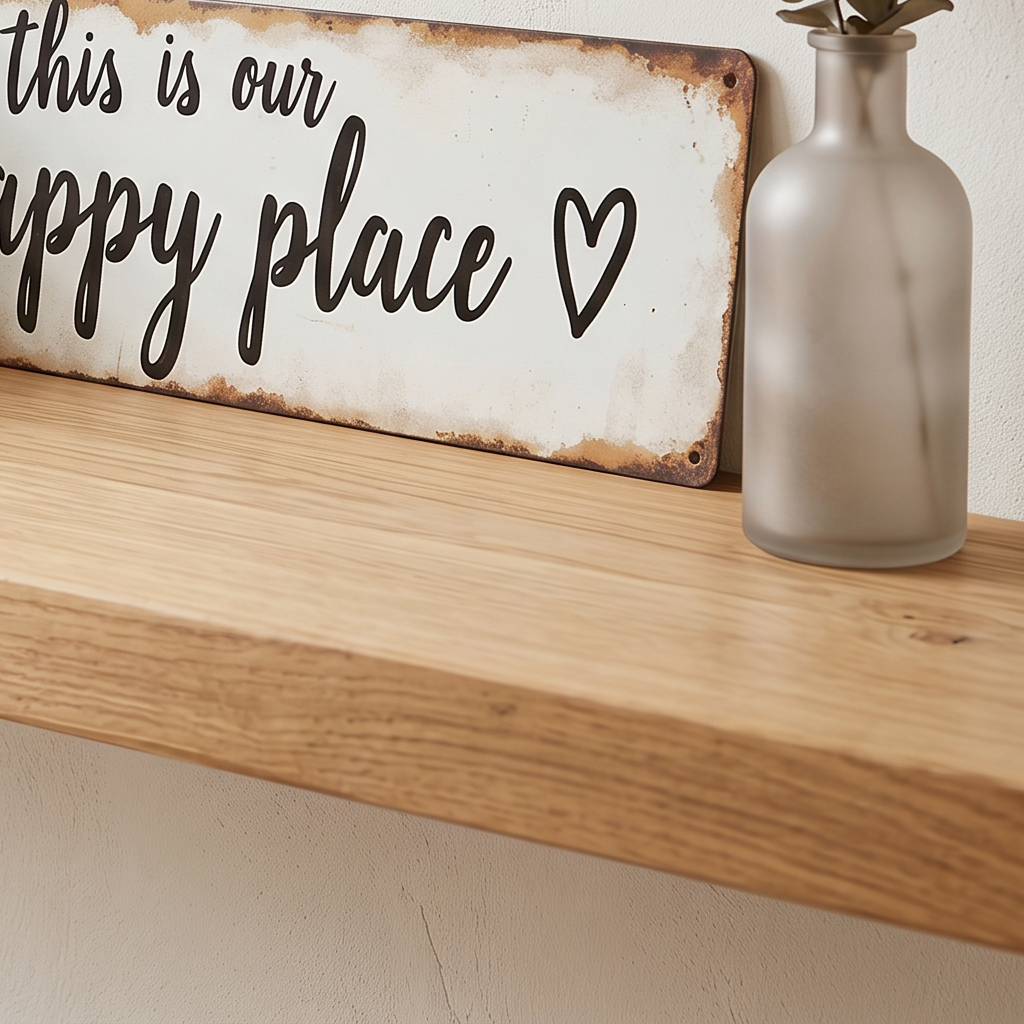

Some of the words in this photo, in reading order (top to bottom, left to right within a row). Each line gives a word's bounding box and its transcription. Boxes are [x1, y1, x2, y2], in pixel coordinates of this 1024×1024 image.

[157, 33, 201, 116] is
[232, 56, 337, 129] our
[238, 114, 513, 366] place
